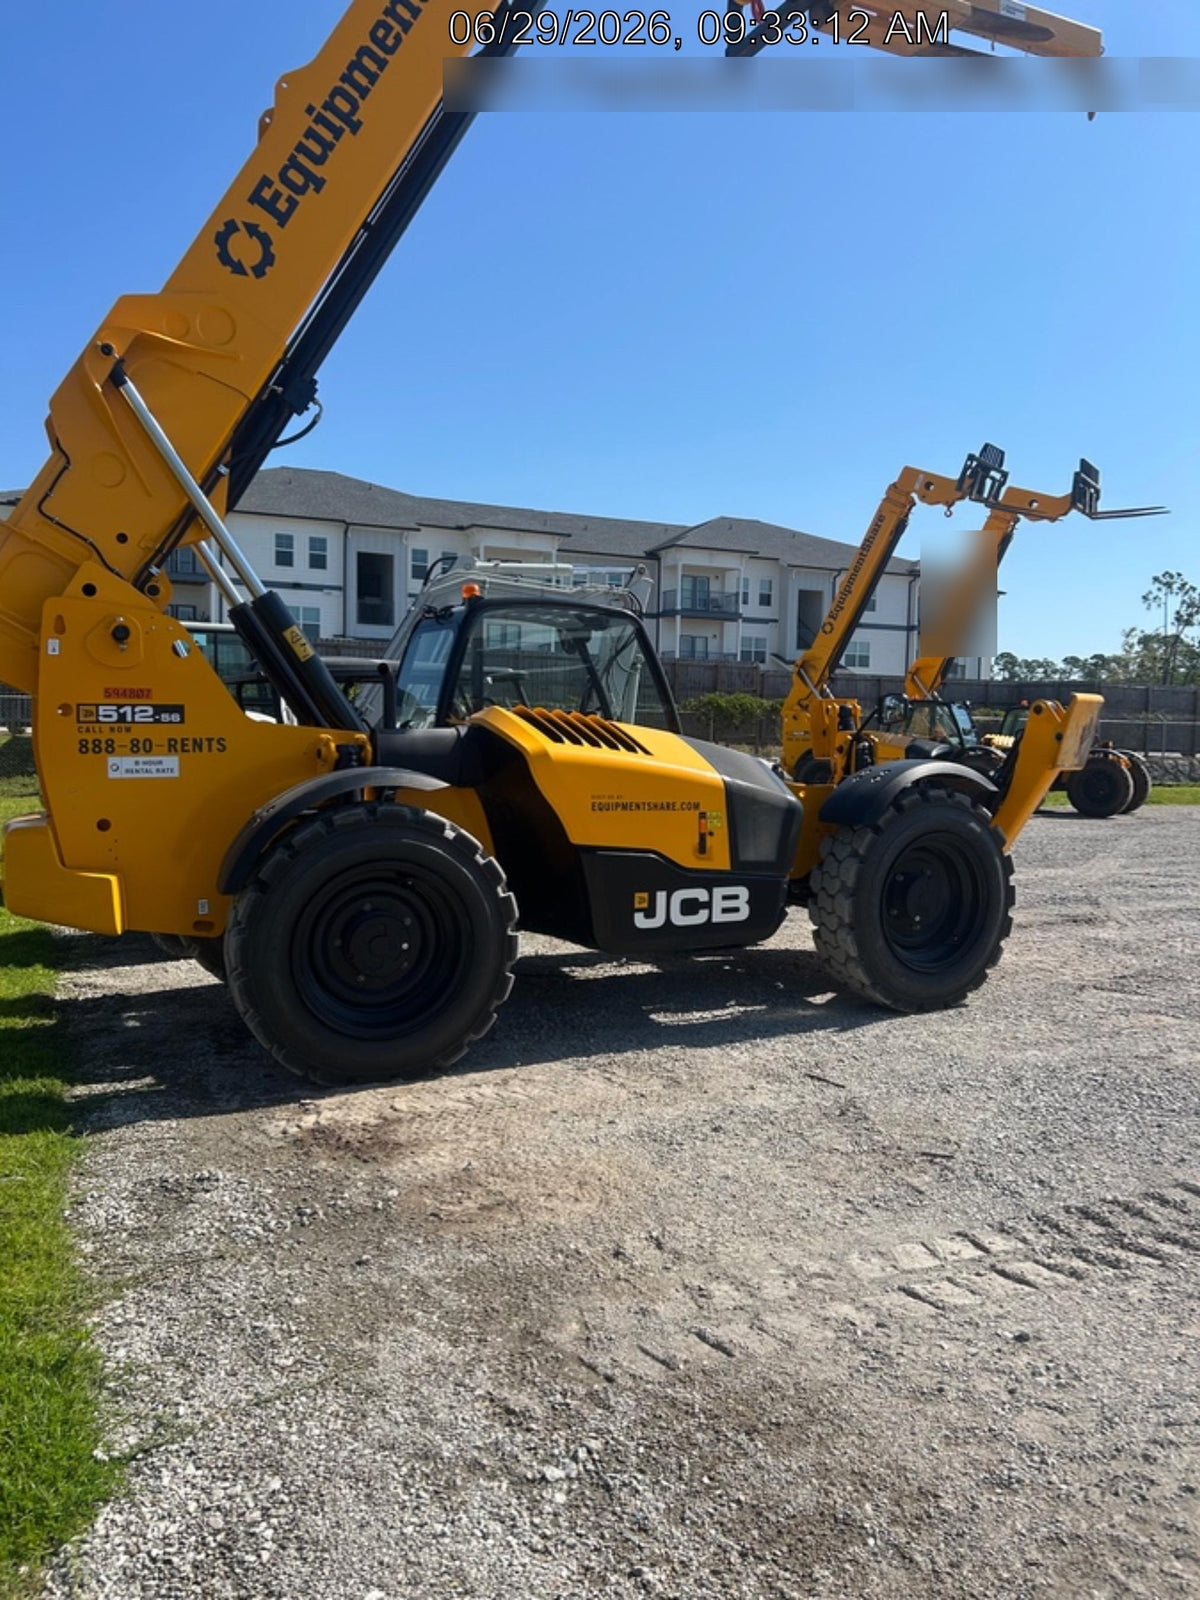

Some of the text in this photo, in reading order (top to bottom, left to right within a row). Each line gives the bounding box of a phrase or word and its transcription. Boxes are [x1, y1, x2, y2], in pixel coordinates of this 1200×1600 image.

[247, 0, 429, 229] Equipmen
[828, 514, 886, 621] EquipmentShare
[78, 737, 227, 754] 888-80-RENTS
[591, 801, 701, 812] EQUIPMENTSHARE.COM
[634, 886, 750, 929] JCB
